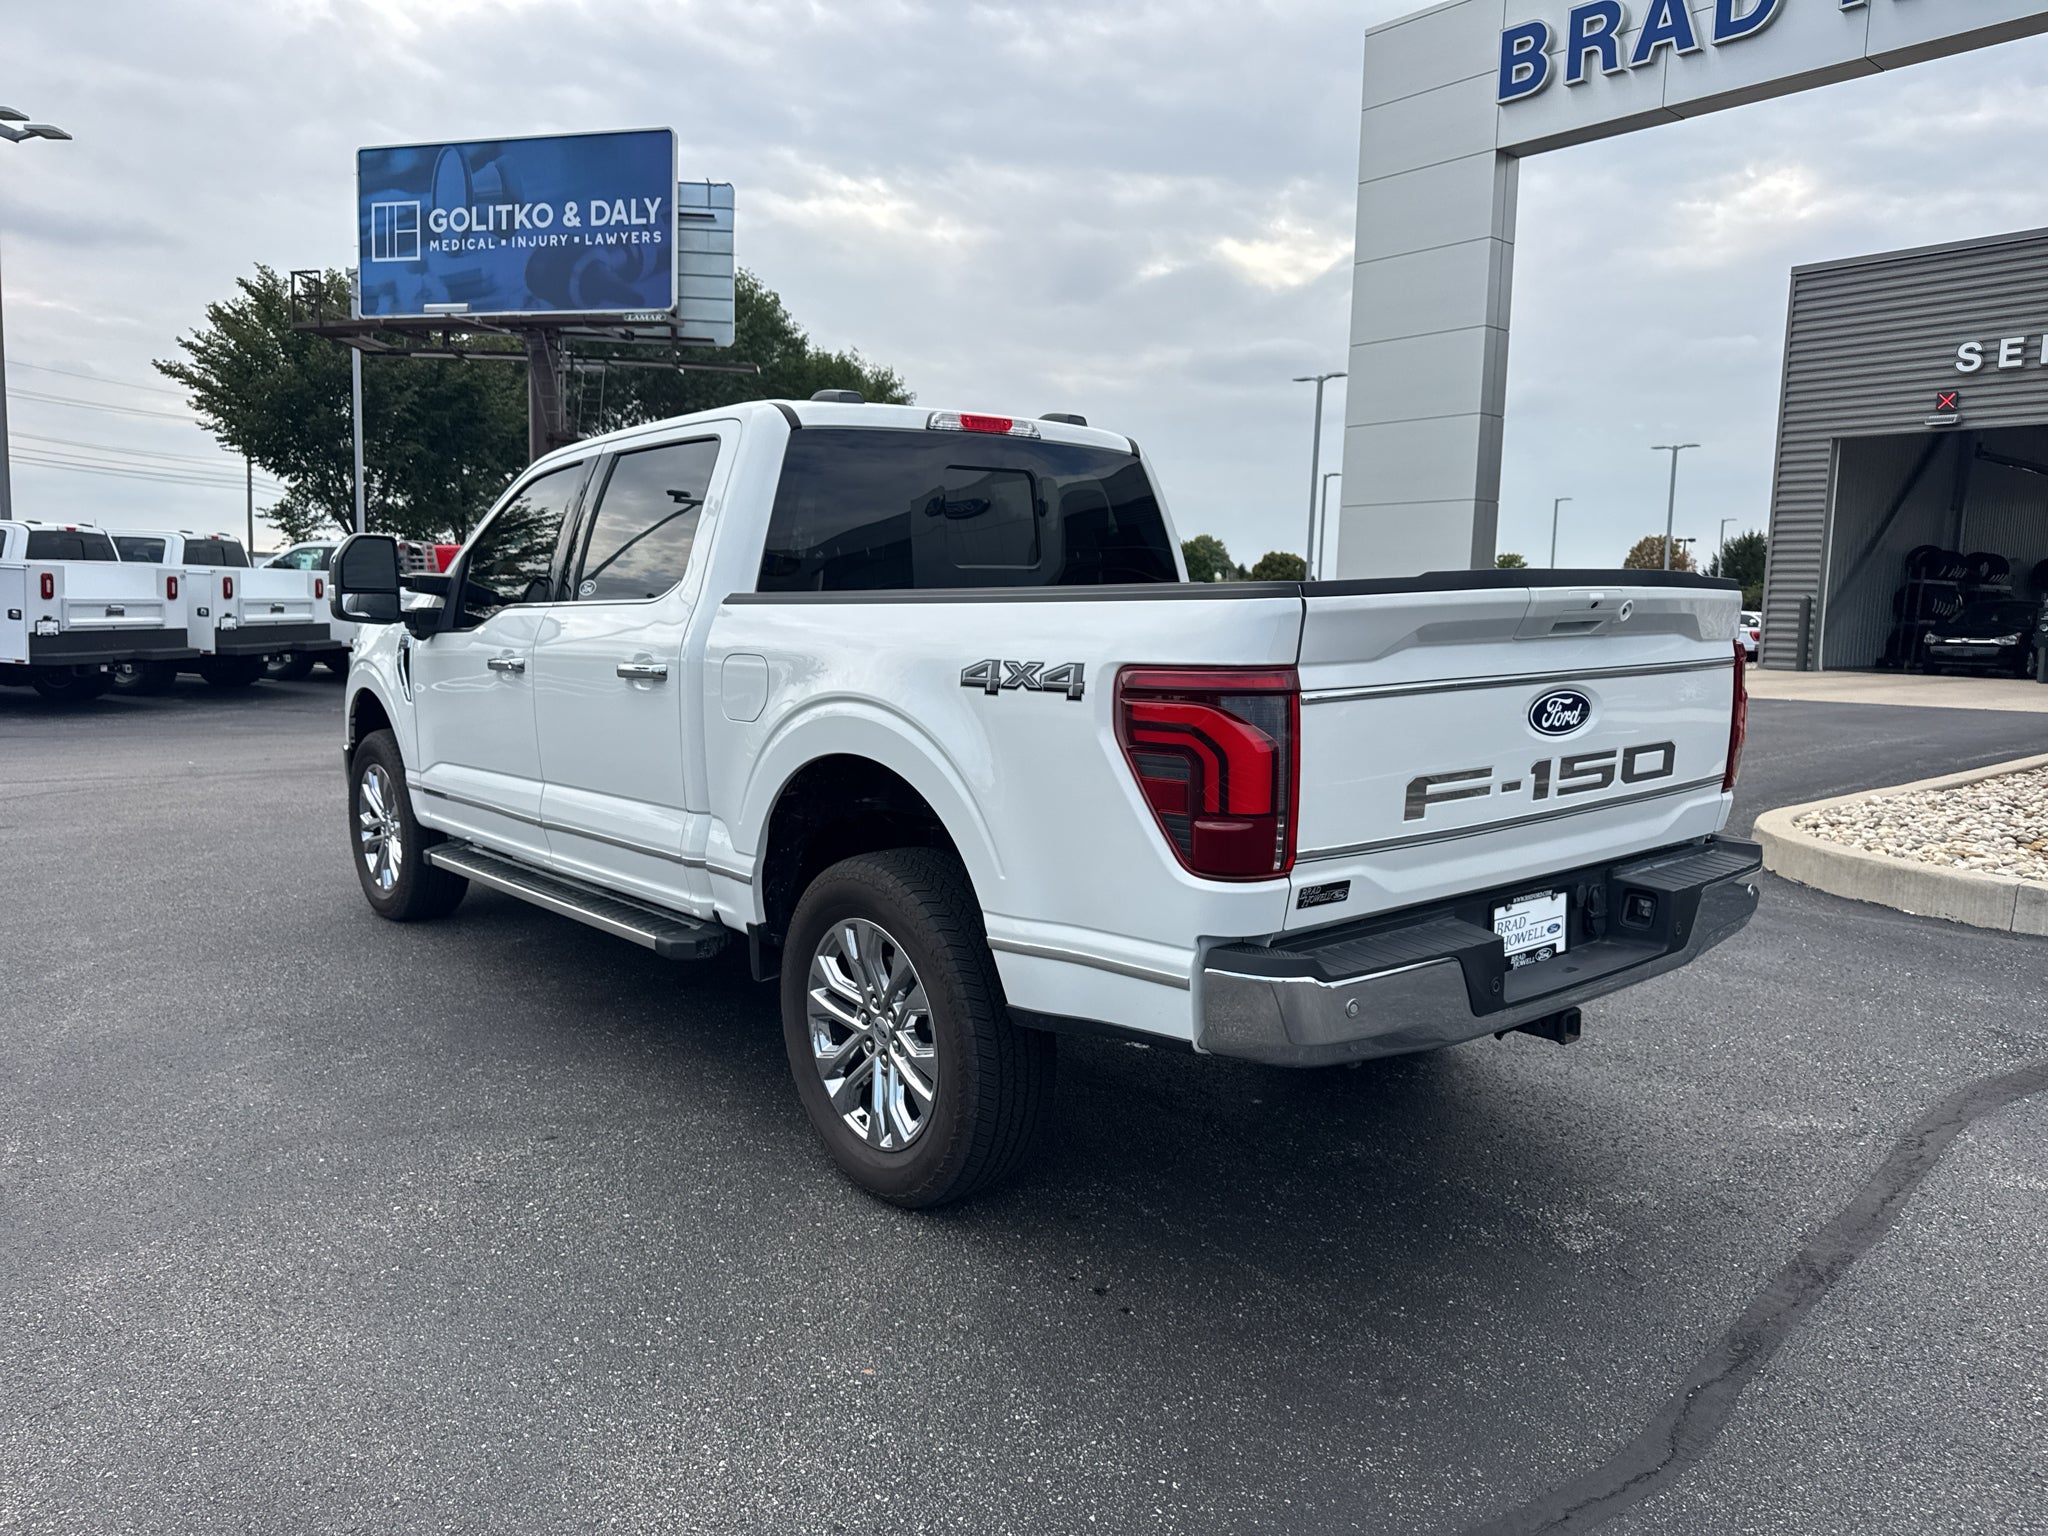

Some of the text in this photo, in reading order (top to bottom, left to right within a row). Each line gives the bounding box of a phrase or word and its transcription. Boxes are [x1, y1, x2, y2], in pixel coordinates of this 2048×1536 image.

[428, 197, 662, 233] GOLITKO & DALY
[429, 231, 662, 252] MEDICAL INJURY LAWYERS
[627, 313, 662, 321] LAMAR
[1541, 697, 1582, 728] Ford
[1402, 740, 1677, 823] F-150
[1496, 916, 1527, 936] BRAD
